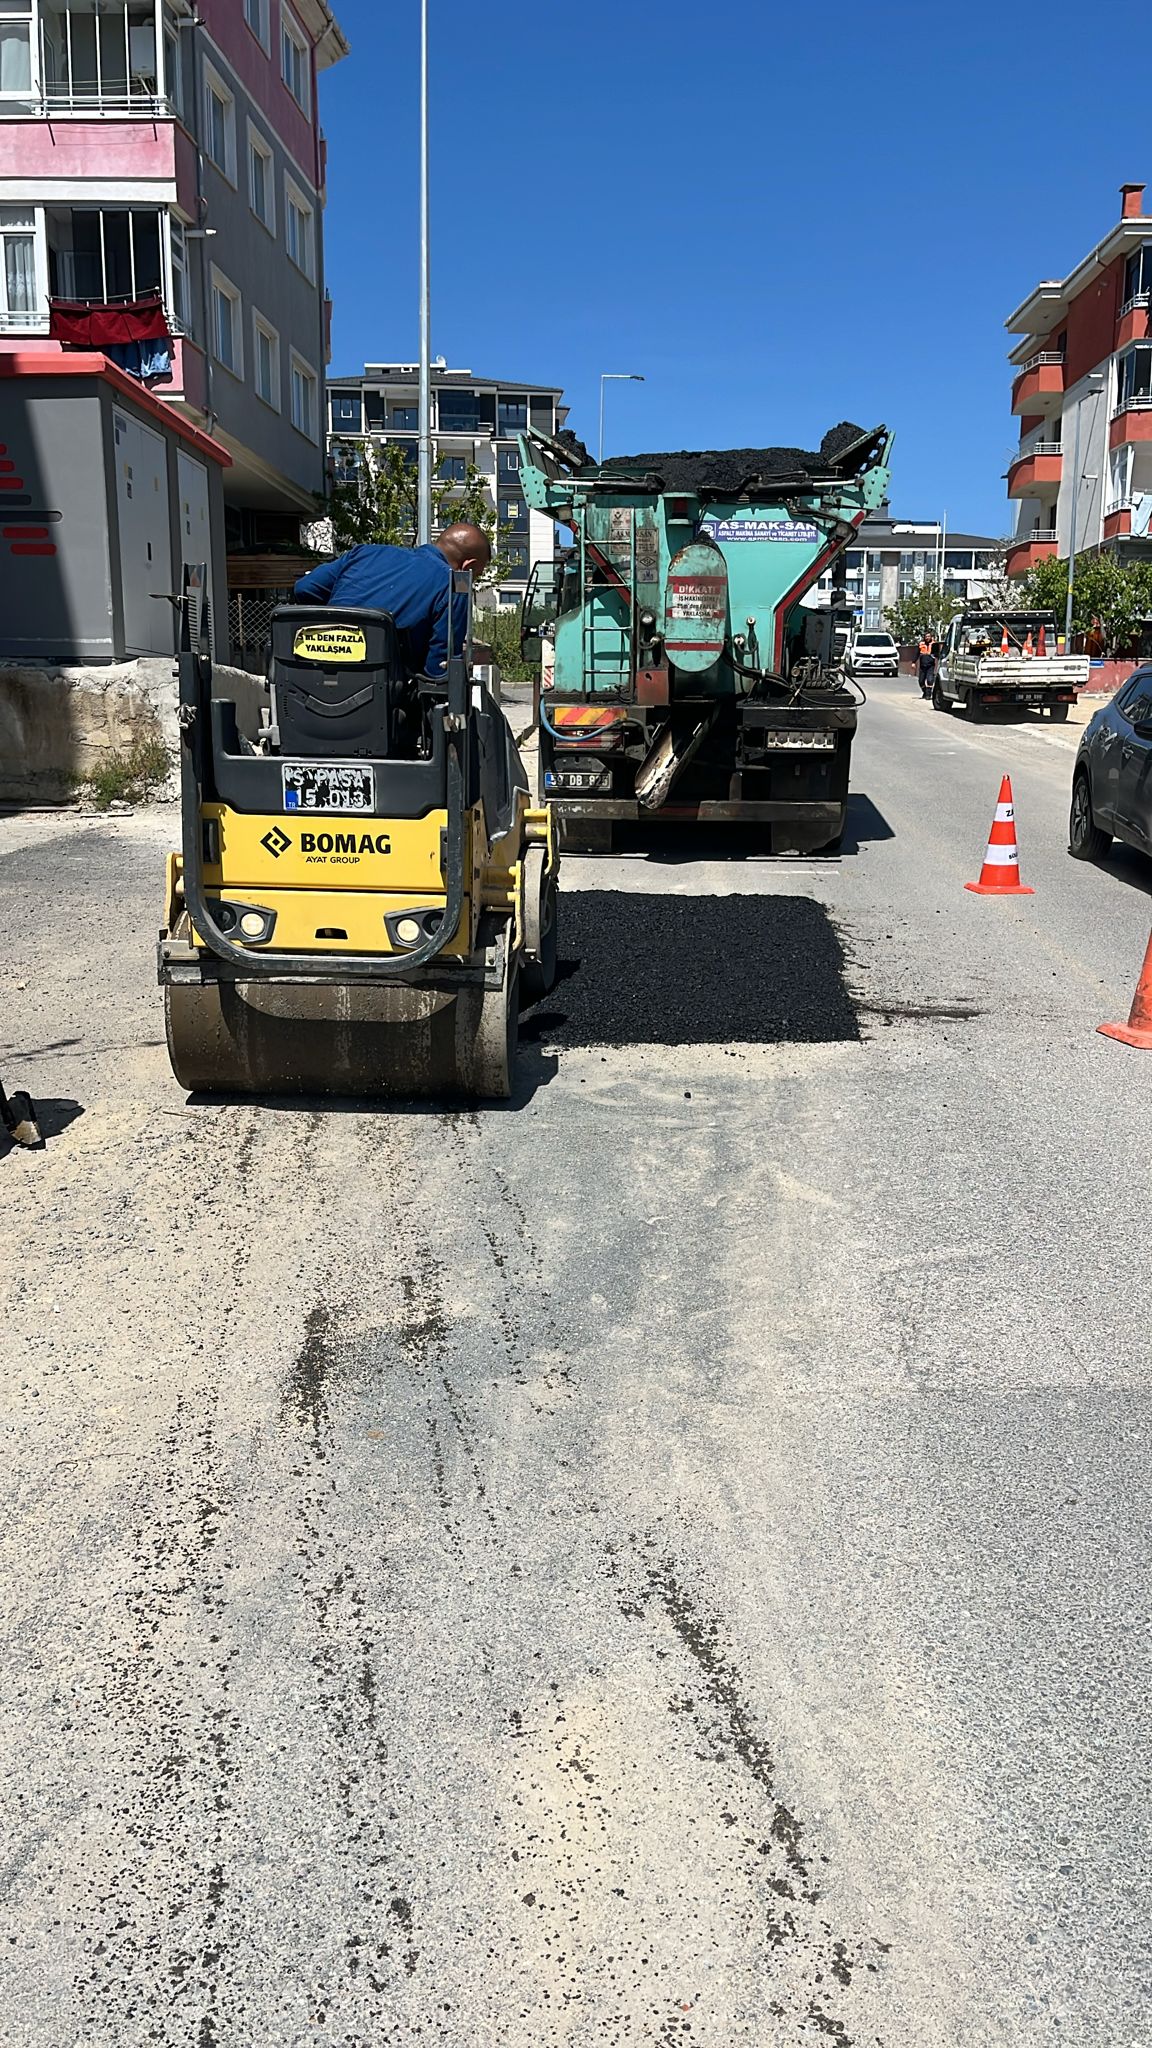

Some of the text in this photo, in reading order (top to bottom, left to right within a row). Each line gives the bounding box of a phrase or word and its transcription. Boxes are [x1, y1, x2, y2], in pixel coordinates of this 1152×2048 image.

[718, 521, 817, 531] AS-MAK-SAN
[317, 634, 334, 642] DEN
[336, 634, 364, 644] FAZLA
[305, 644, 352, 655] YAKLAŞMA
[569, 774, 583, 786] DB
[300, 833, 391, 854] BOMAG
